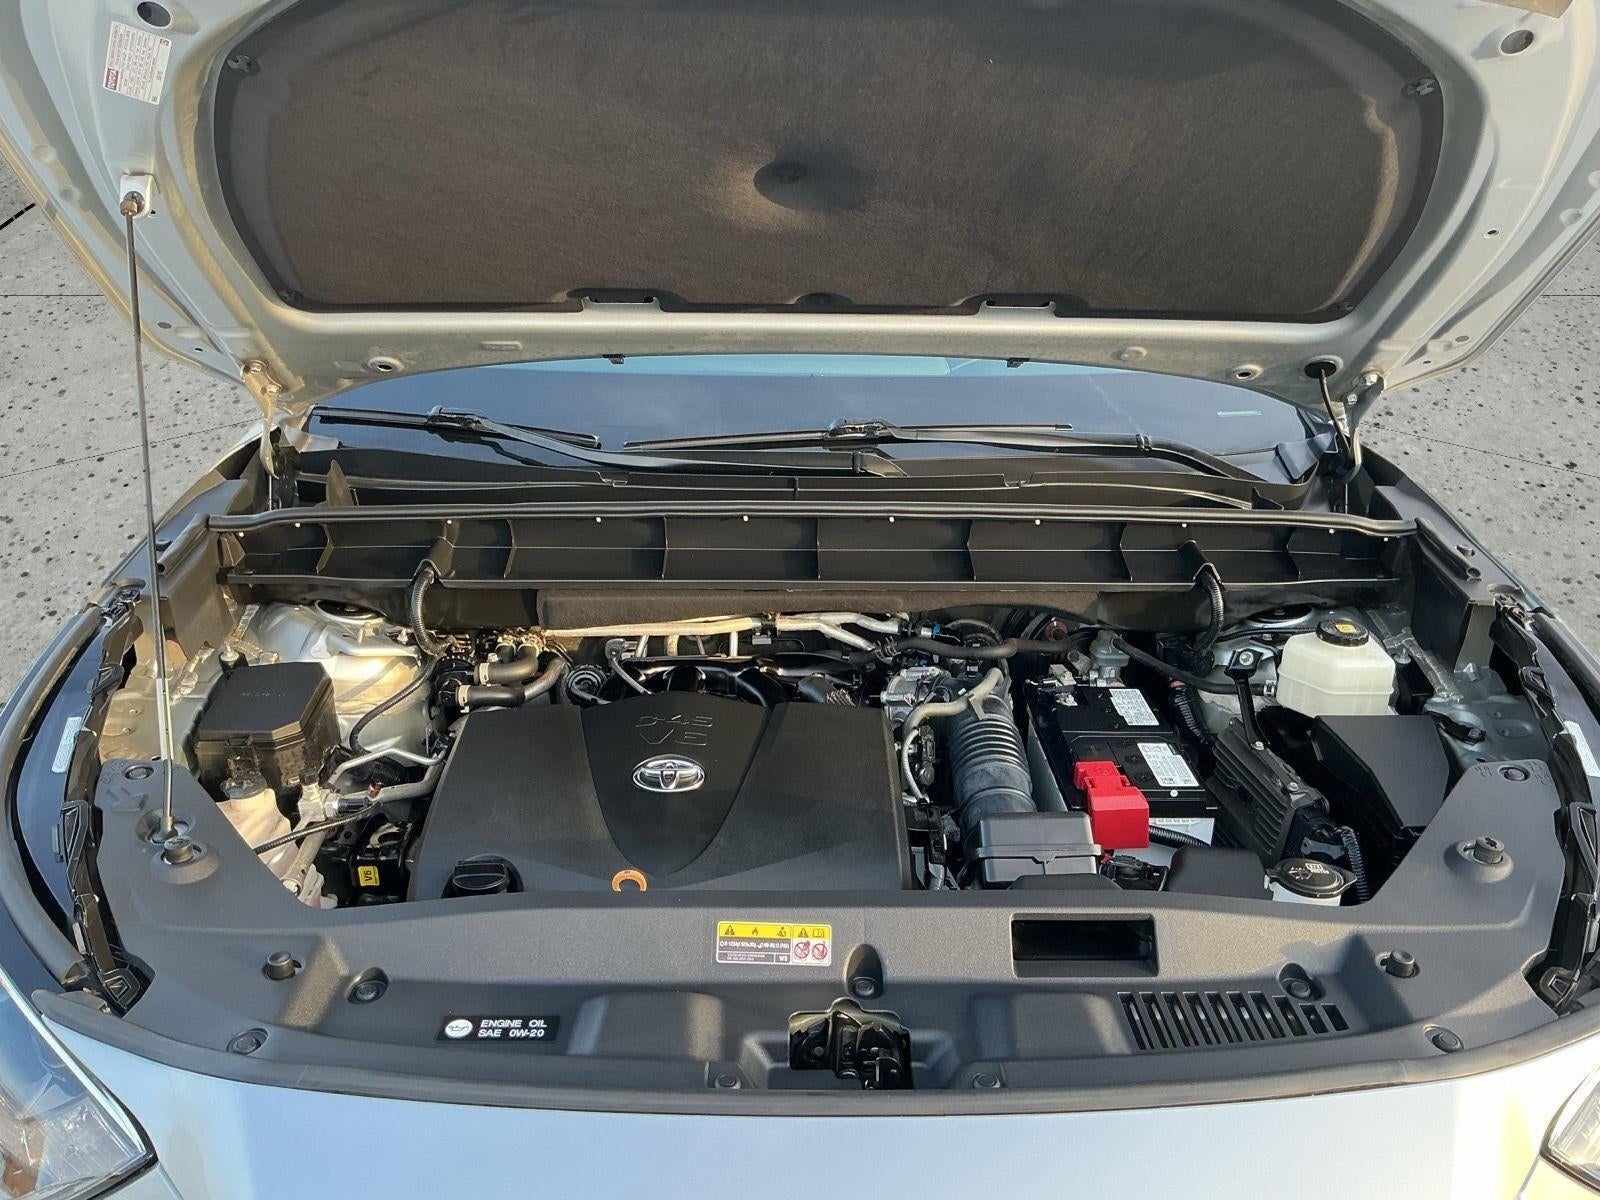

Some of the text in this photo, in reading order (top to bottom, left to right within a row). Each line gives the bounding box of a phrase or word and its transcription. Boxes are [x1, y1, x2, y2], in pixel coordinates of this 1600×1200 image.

[639, 729, 707, 746] V6
[364, 870, 373, 882] V6
[480, 1019, 547, 1028] ENGINE OIL
[478, 1029, 544, 1037] SAE 0W-20
